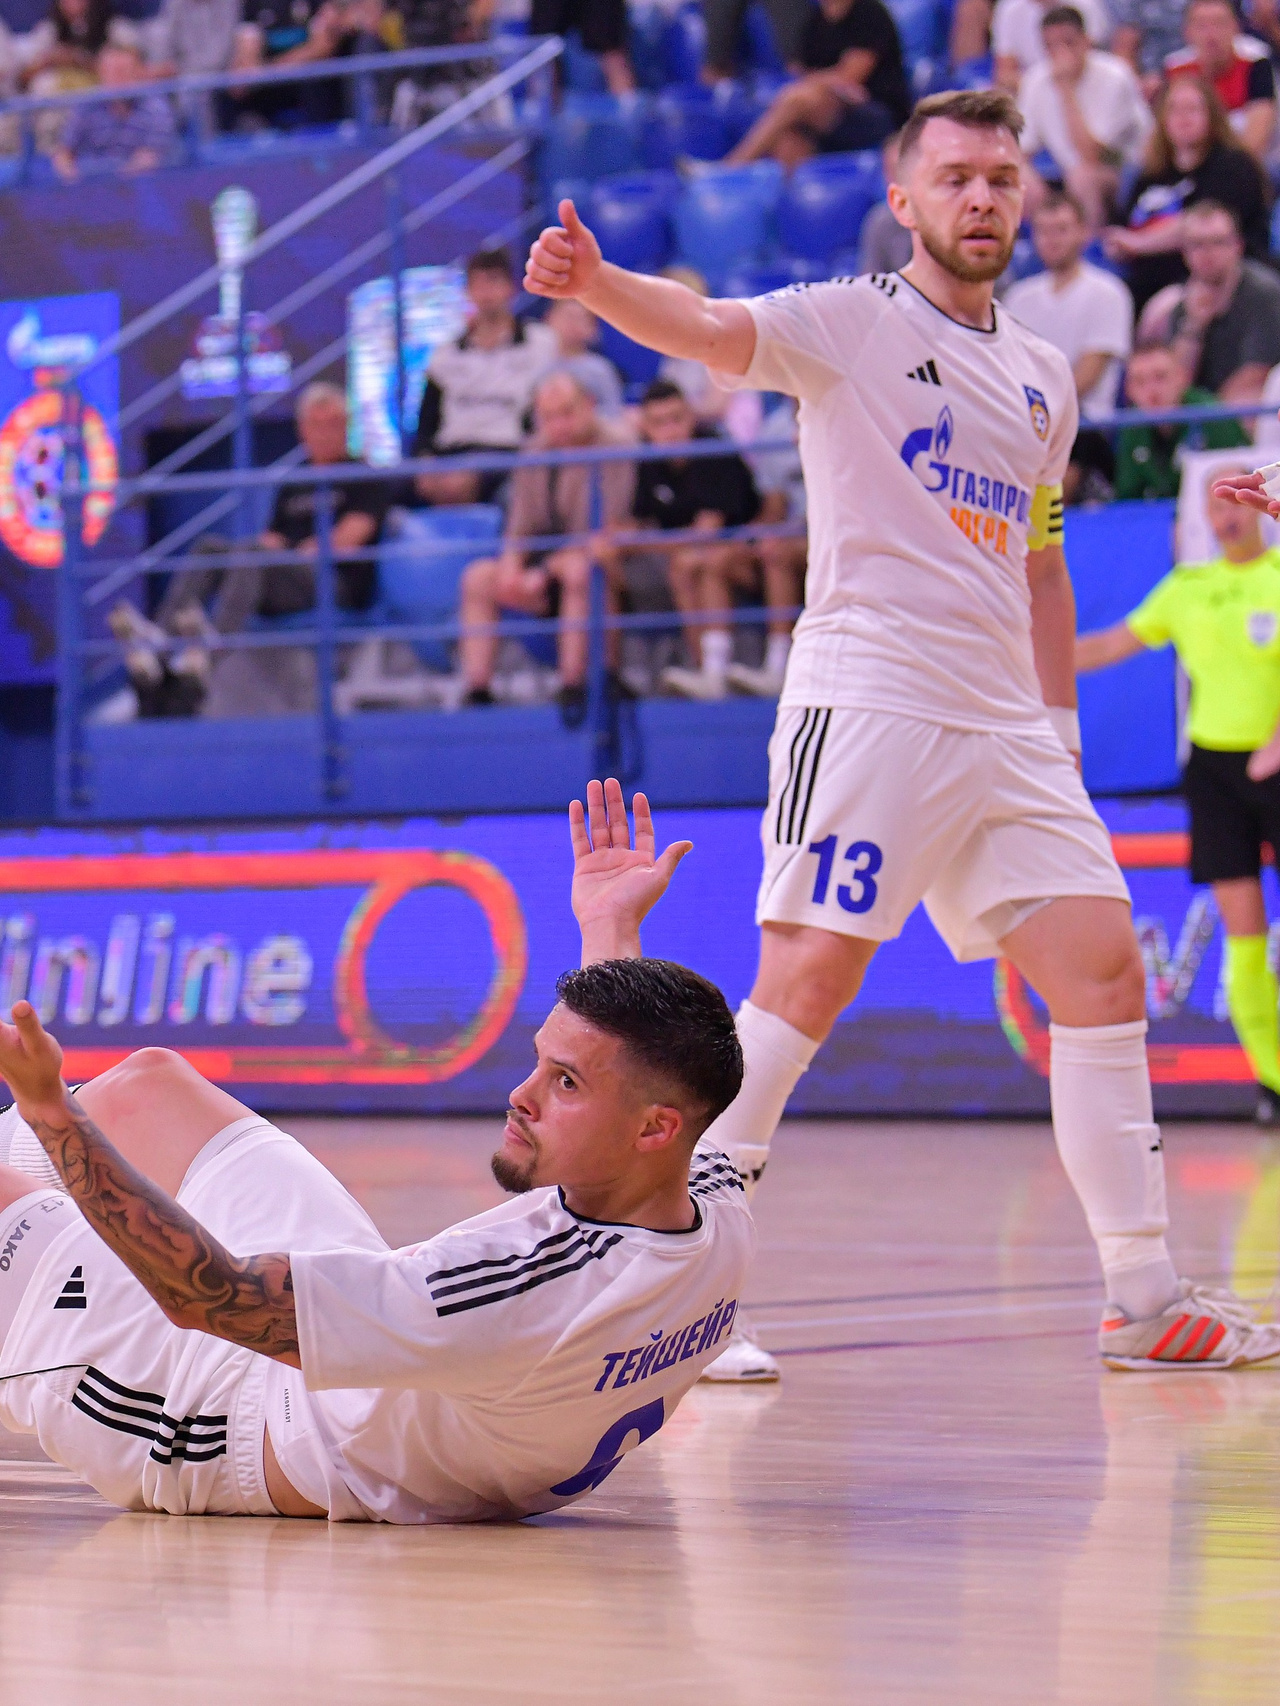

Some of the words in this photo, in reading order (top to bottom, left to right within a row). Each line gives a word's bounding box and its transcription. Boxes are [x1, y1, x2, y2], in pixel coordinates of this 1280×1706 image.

[808, 833, 883, 914] 13
[0, 1219, 31, 1271] JAKO
[593, 1297, 739, 1392] ТЕЙШЕЙР
